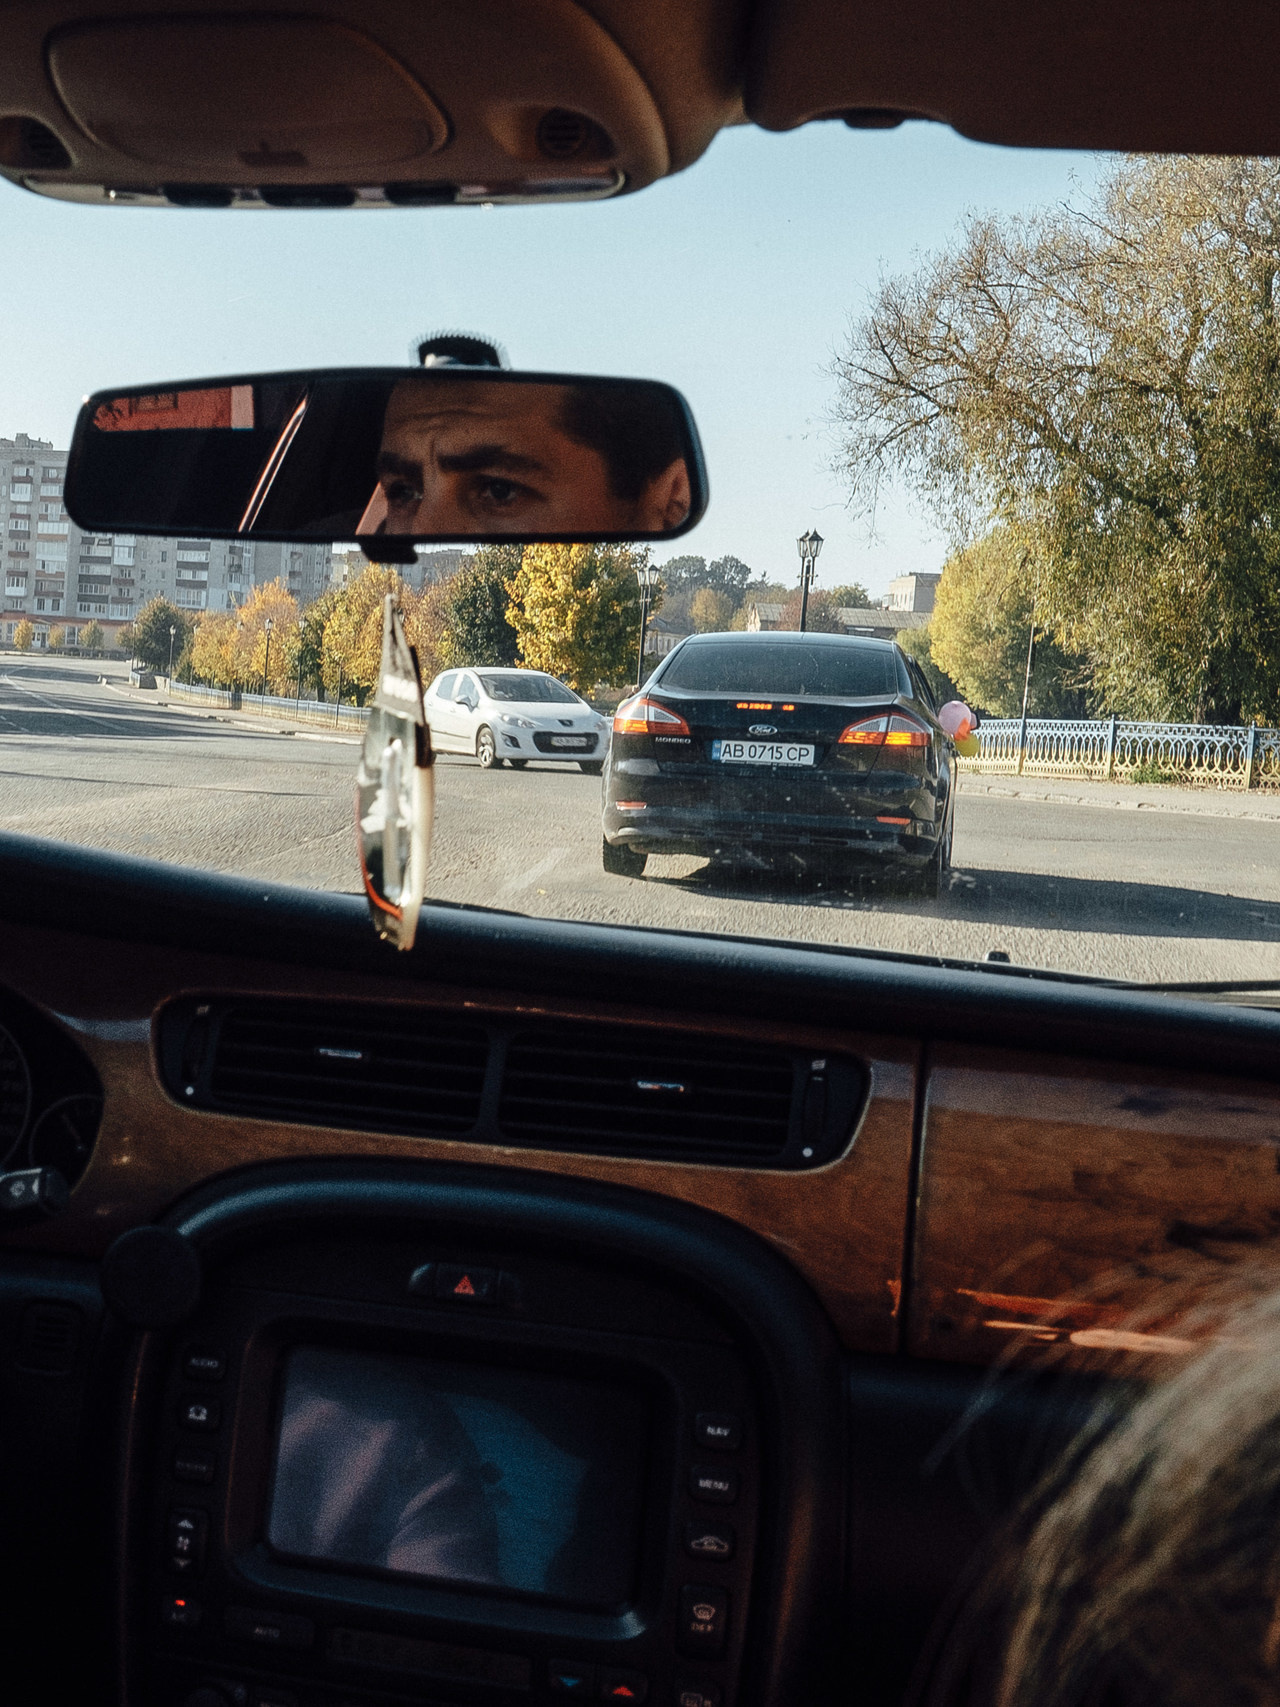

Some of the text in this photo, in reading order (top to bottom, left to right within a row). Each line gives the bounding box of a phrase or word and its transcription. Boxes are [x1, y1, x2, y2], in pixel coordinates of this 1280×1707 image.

[722, 743, 810, 761] AB 0715 CP
[705, 1425, 730, 1437] NAV
[698, 1478, 729, 1491] MENU
